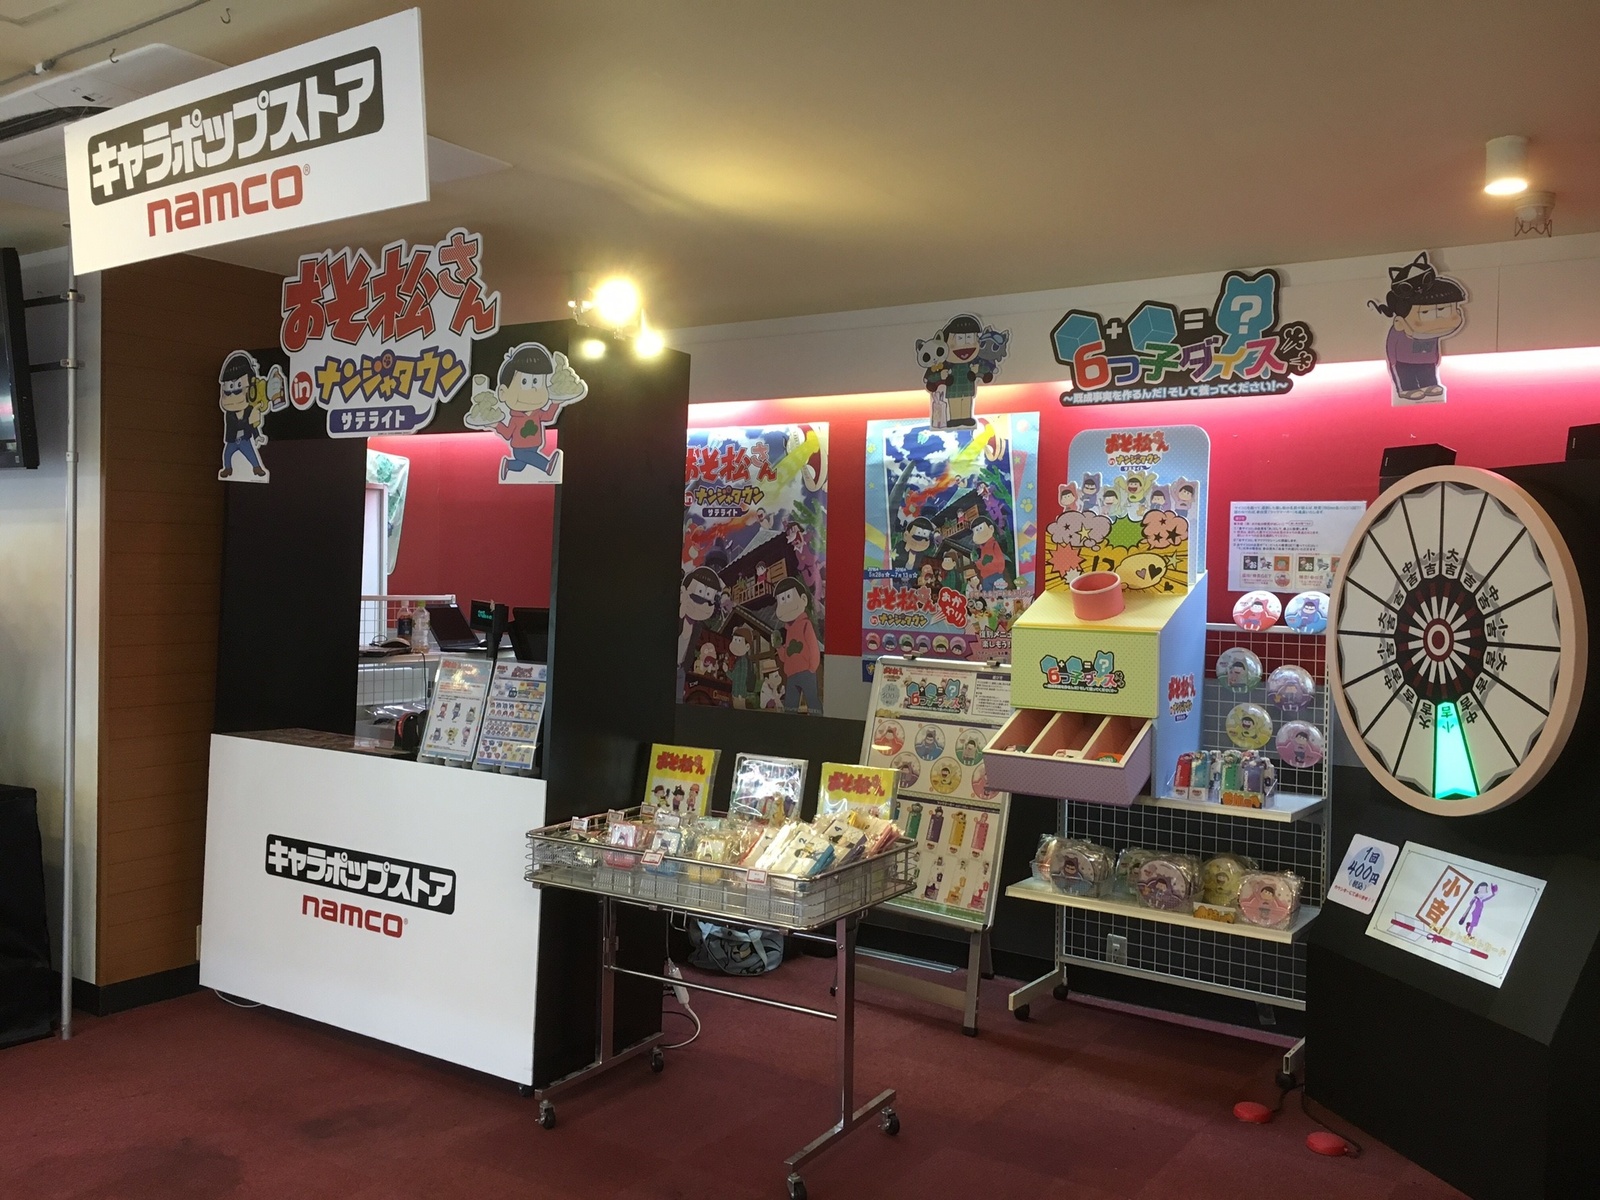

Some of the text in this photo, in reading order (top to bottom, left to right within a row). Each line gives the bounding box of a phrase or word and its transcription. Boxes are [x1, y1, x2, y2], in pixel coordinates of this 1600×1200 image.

[92, 59, 375, 196] キャラポップストア
[147, 165, 303, 237] namco
[283, 233, 497, 350] おそ松さん
[293, 346, 466, 403] in ナンジャタウン
[1073, 336, 1287, 391] 6つ子ダイス
[342, 411, 405, 430] サテライト
[1105, 431, 1169, 453] おそ松さん
[686, 442, 777, 482] おそ松さん
[708, 509, 738, 517] サテライト
[1402, 562, 1418, 587] 中吉
[1423, 549, 1437, 576] 小吉
[1446, 548, 1459, 576] 大吉
[867, 587, 936, 611] おそ松さん
[1477, 585, 1500, 610] 中吉
[1378, 612, 1396, 631] 大吉
[1486, 617, 1508, 639] 小吉
[1377, 643, 1395, 660] 小吉
[1485, 652, 1507, 672] 大吉
[1047, 666, 1117, 687] 6つ子ダイス
[1384, 669, 1402, 689] 中吉
[1419, 702, 1433, 730] 大吉
[1441, 706, 1455, 733] 小吉
[1460, 696, 1478, 724] 中吉
[656, 751, 706, 775] おそ松さん
[828, 771, 885, 797] おそ松さん
[1364, 847, 1380, 864] 1回
[268, 840, 453, 907] キャラポップストア
[1347, 860, 1380, 885] 400円
[1425, 876, 1461, 923] 小吉
[302, 895, 403, 938] namco
